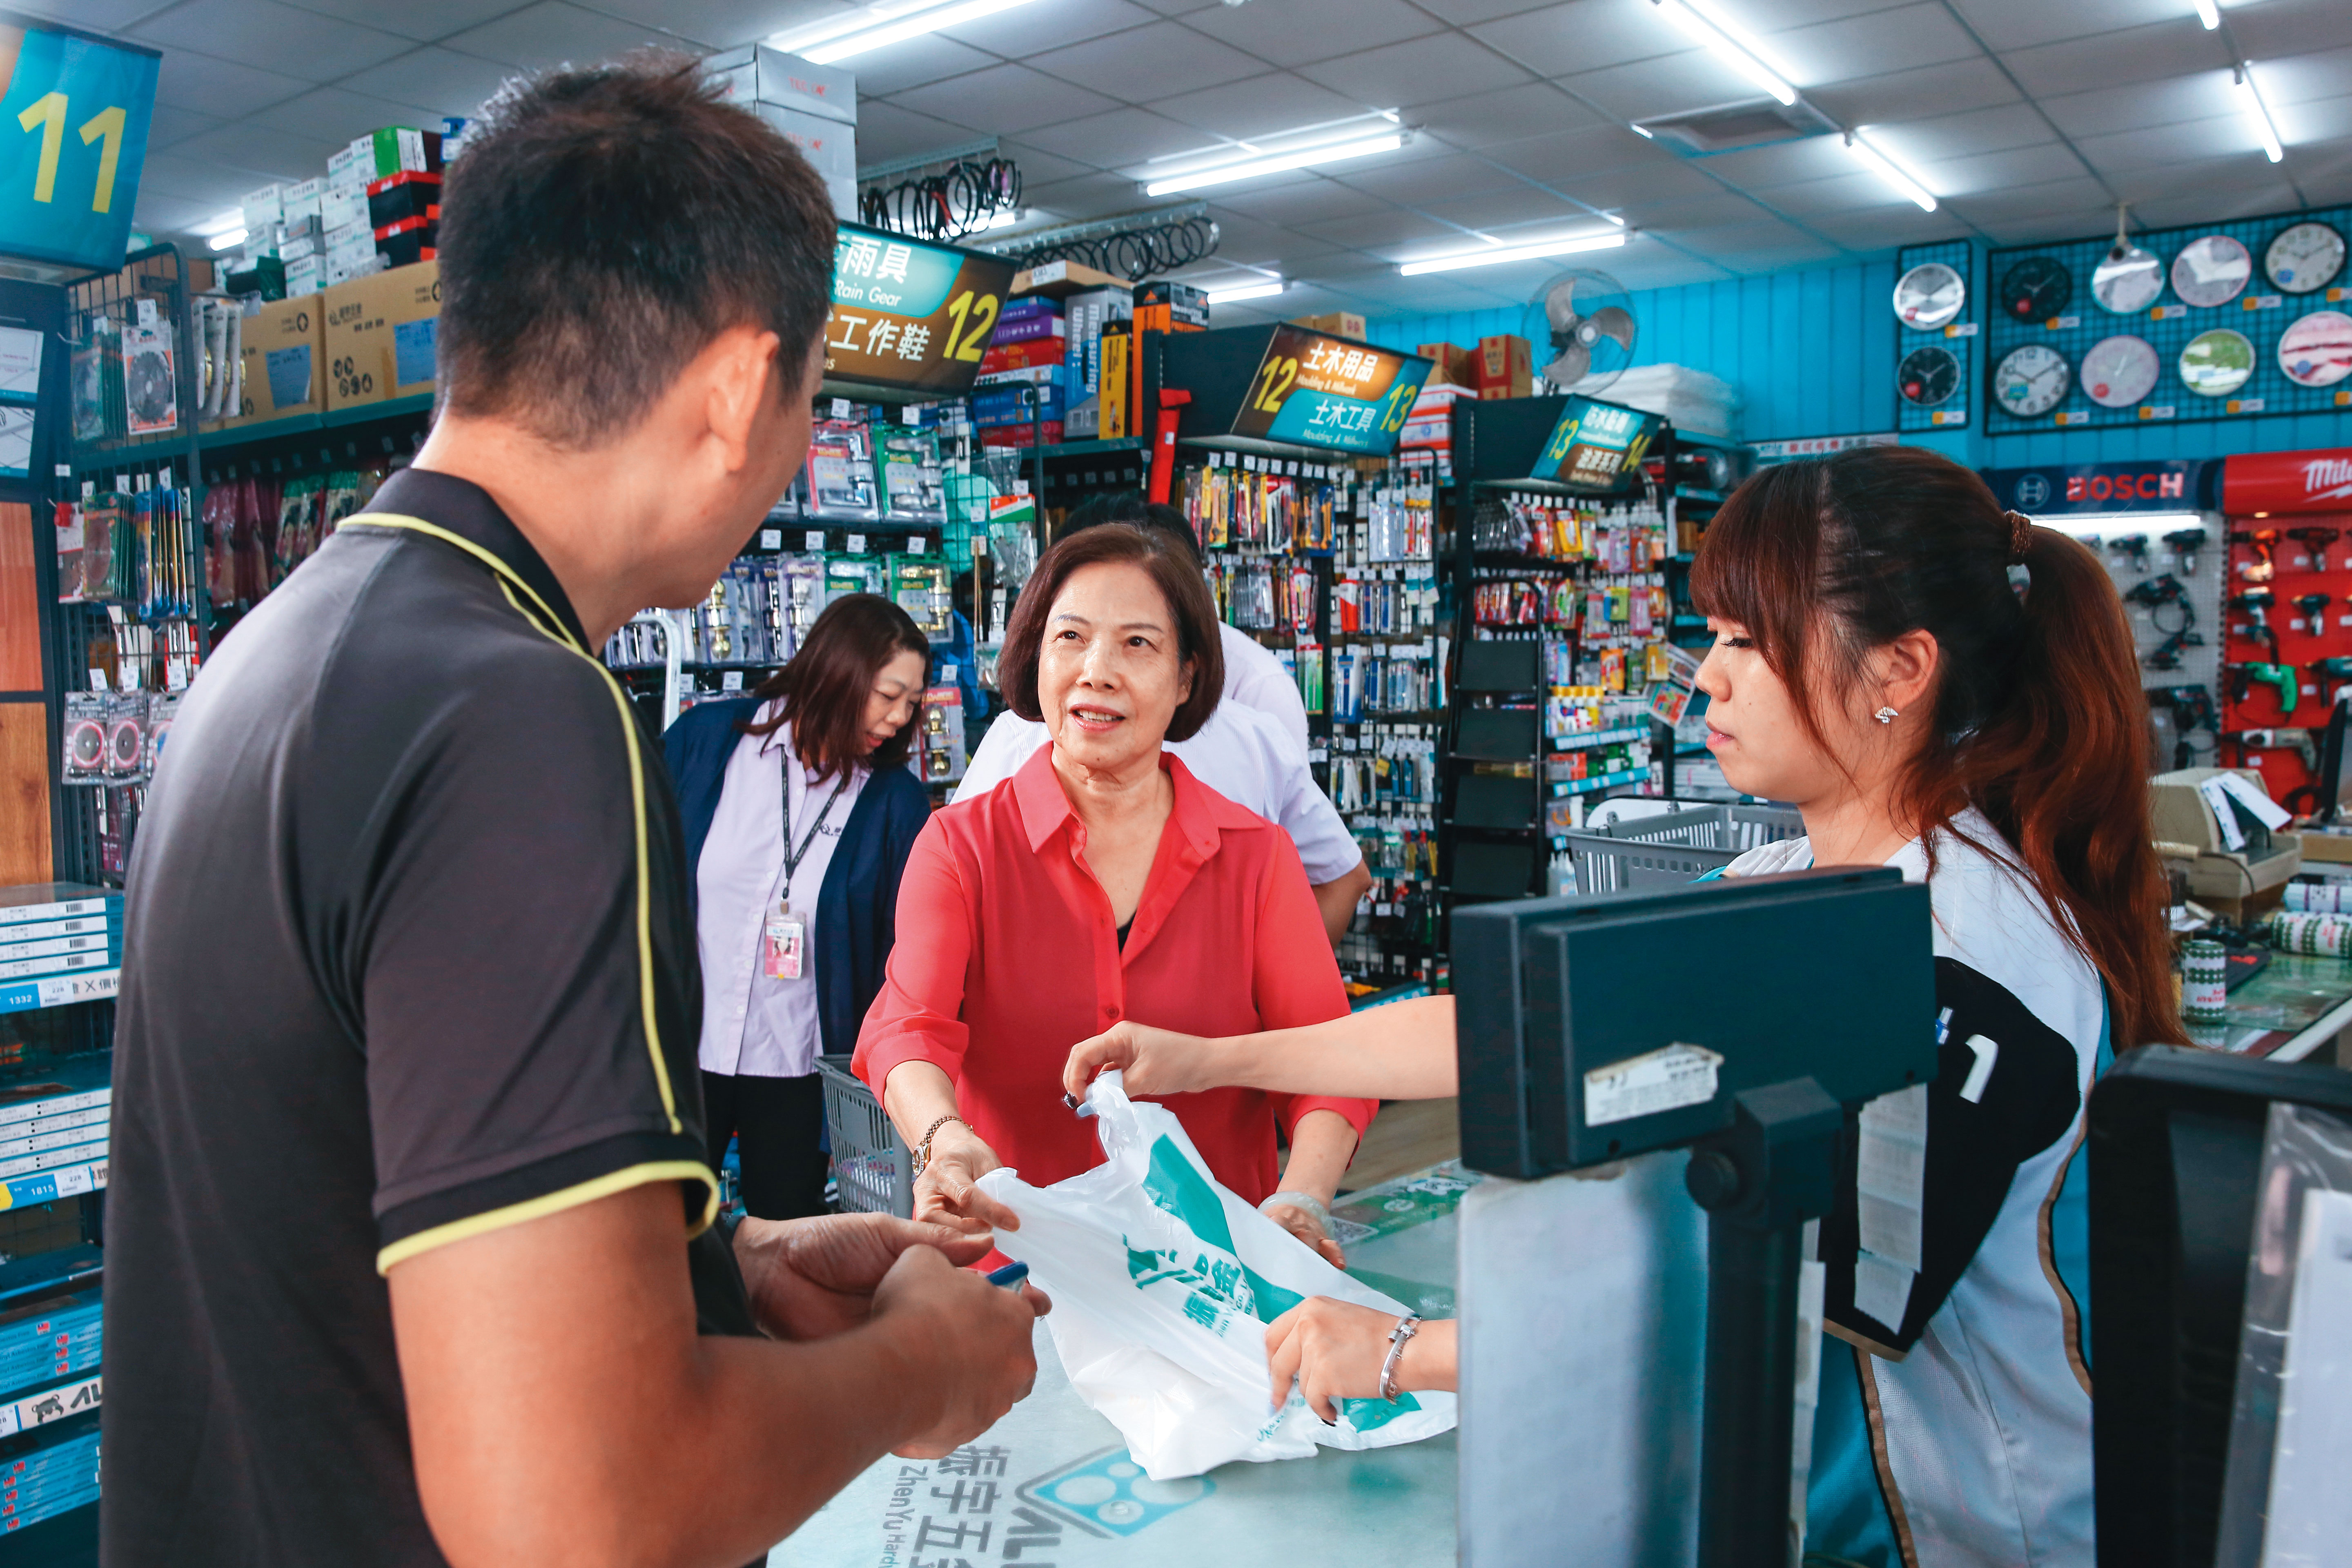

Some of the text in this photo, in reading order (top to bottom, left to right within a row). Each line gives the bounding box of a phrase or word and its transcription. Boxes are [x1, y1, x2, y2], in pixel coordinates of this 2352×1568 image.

[18, 92, 126, 213] 11
[843, 236, 911, 284] 雨具
[834, 280, 902, 307] Rain Gear
[824, 309, 931, 361] 工作鞋
[942, 290, 998, 363] 12
[1253, 356, 1298, 413] 12
[1303, 342, 1379, 383] 土木用品
[1308, 399, 1377, 433] 土木工具
[1380, 383, 1417, 432] 13
[1548, 419, 1579, 460] 13
[2066, 472, 2184, 502] BOSCH
